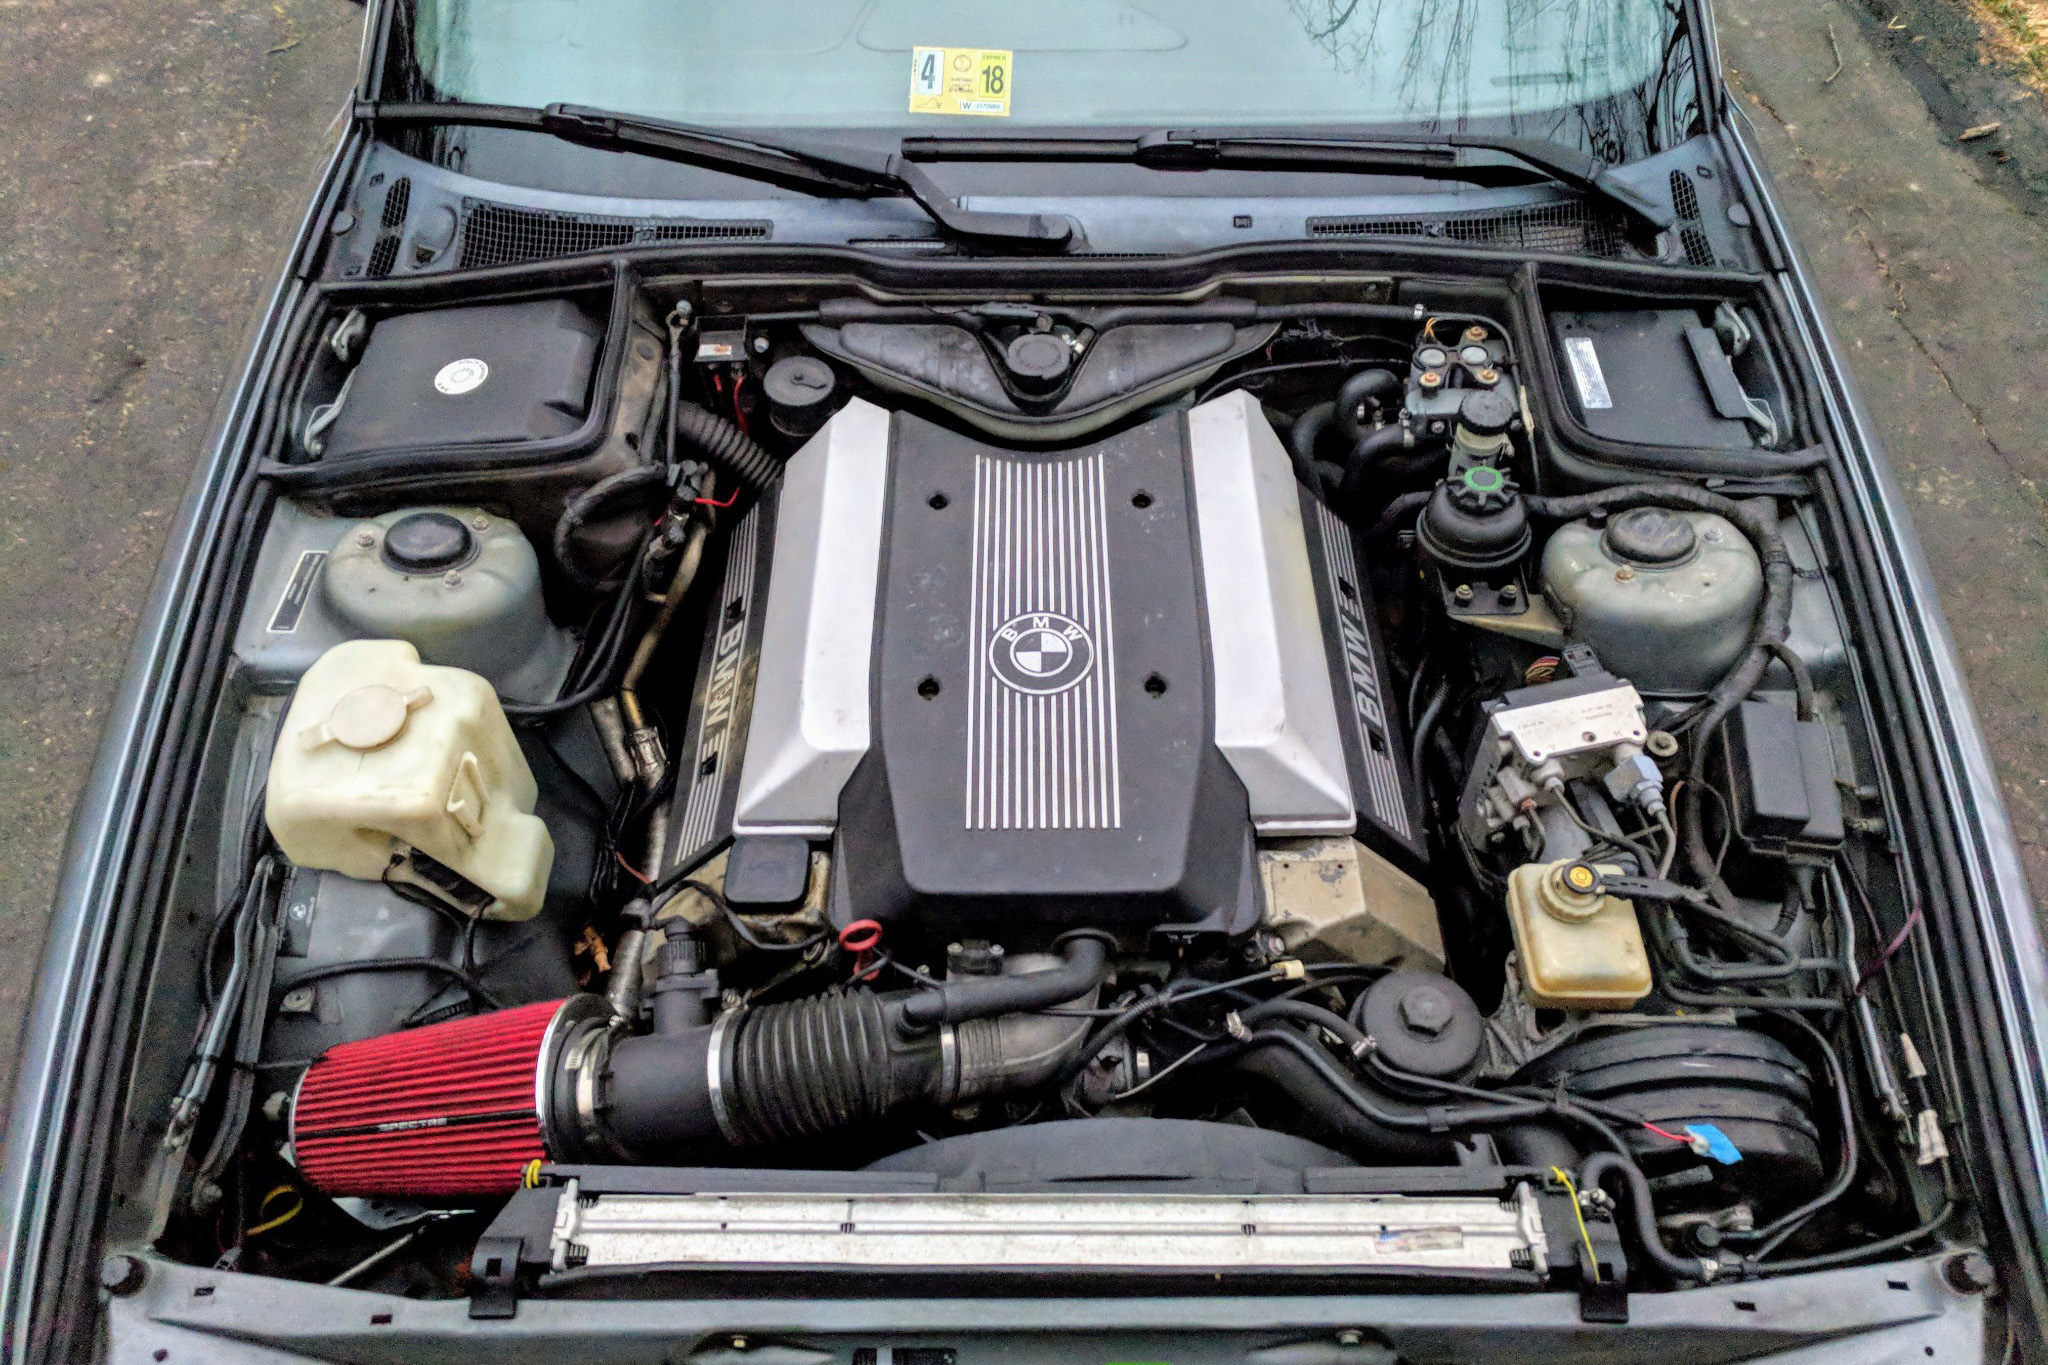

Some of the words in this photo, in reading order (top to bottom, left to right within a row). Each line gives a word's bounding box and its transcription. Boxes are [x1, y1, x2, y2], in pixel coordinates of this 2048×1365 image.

[921, 54, 935, 90] 4
[982, 65, 1004, 94] 18
[963, 102, 972, 110] W
[1000, 616, 1083, 642] BMW
[707, 620, 743, 726] BMW
[1342, 614, 1382, 727] BMW
